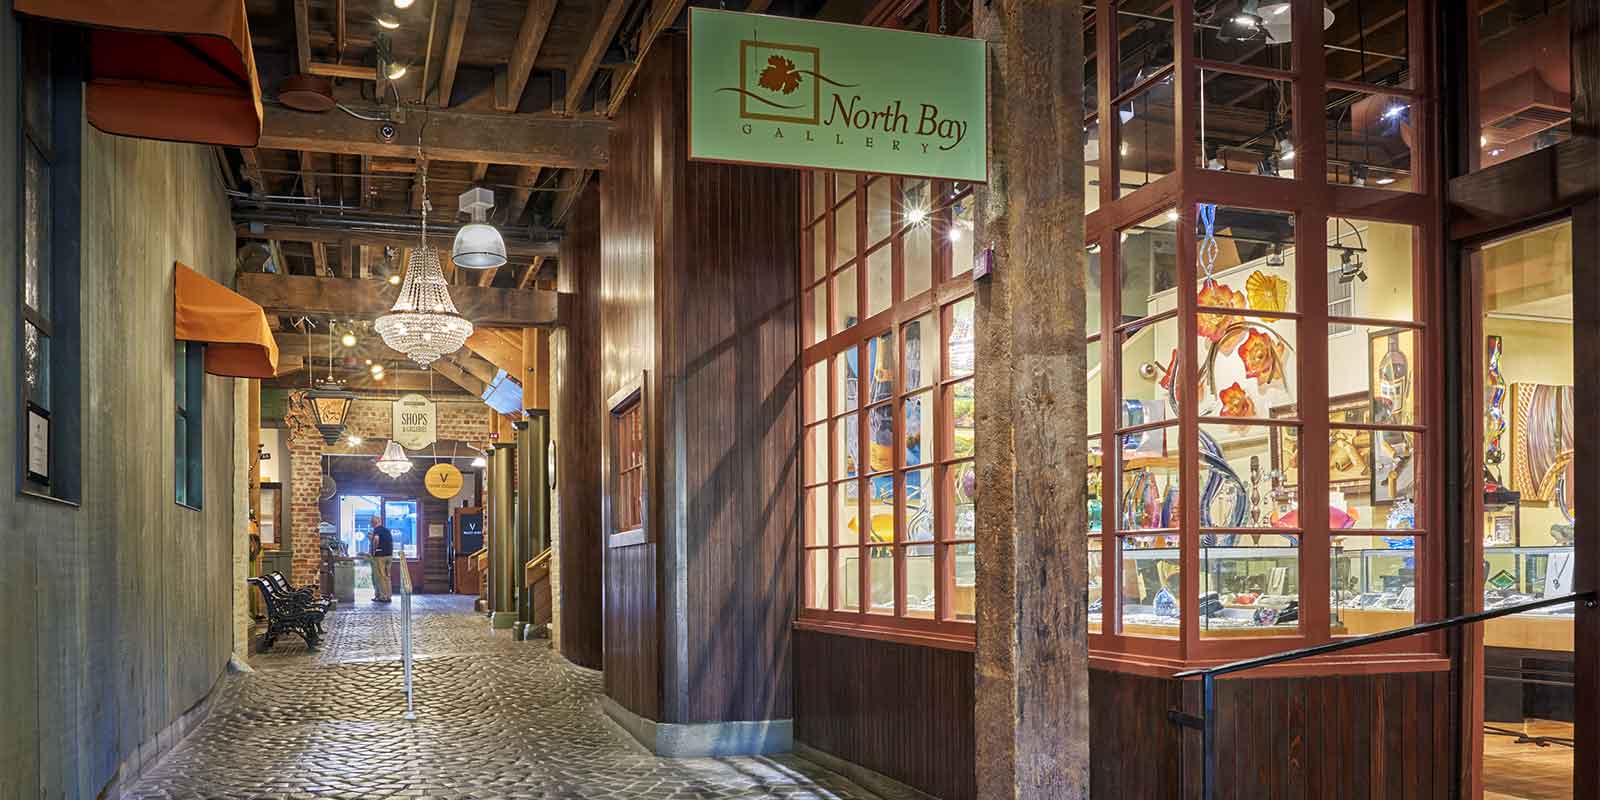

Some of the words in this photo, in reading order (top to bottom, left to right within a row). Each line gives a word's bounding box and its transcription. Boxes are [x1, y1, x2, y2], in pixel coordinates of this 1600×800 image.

[824, 93, 911, 134] North
[915, 103, 968, 151] Bay
[742, 123, 930, 154] GALLERY
[401, 412, 429, 426] SHOPS
[440, 473, 449, 483] V
[469, 522, 476, 531] V
